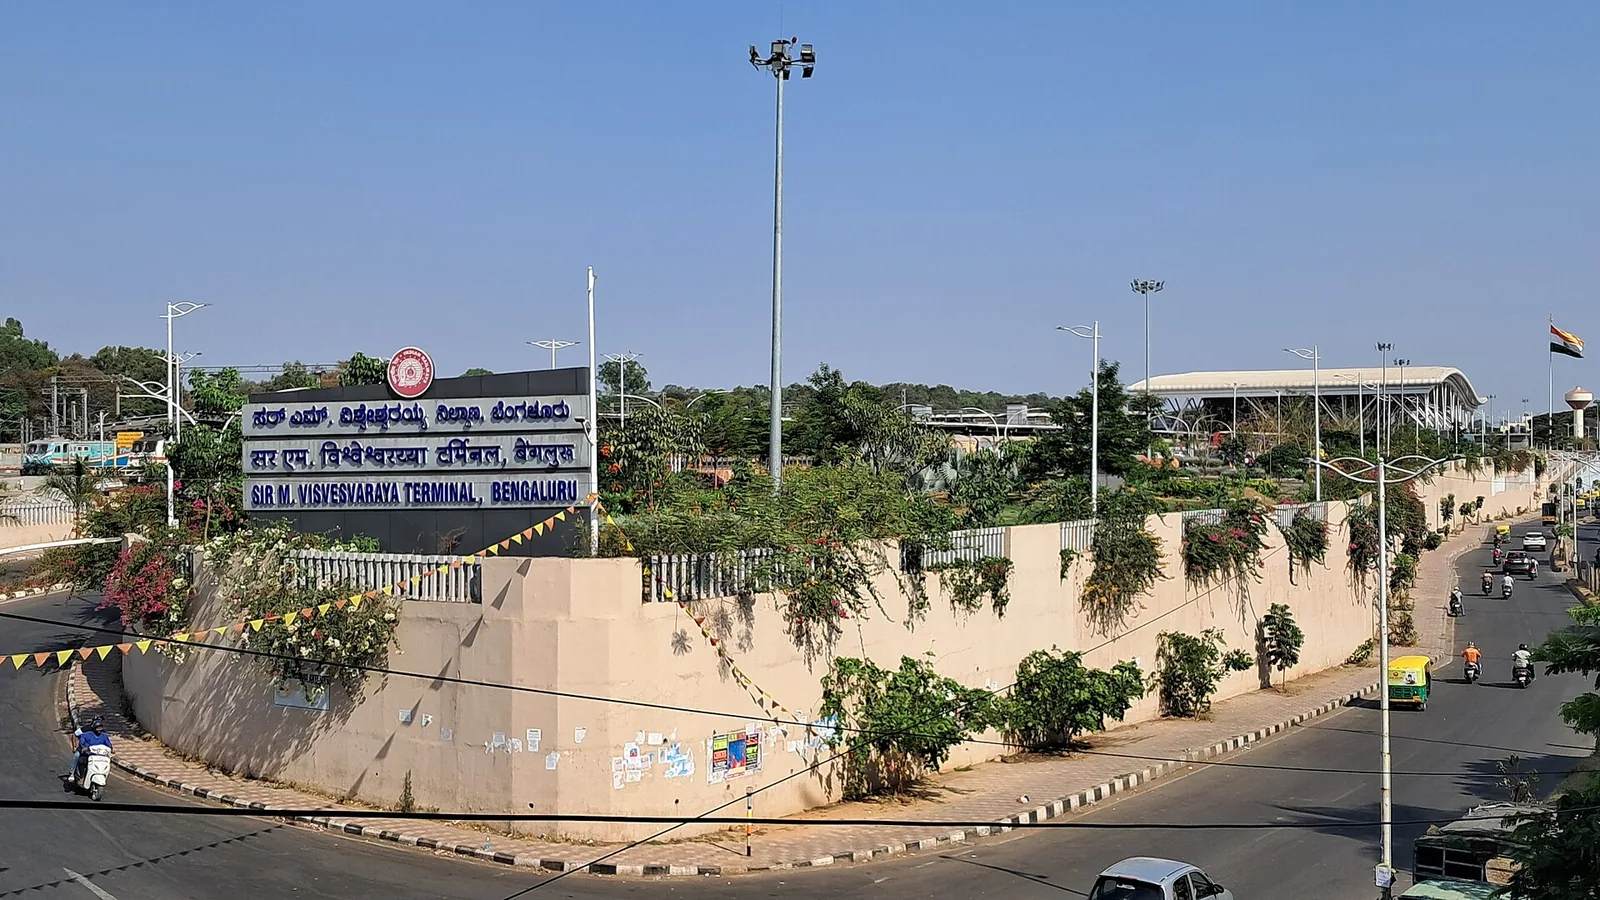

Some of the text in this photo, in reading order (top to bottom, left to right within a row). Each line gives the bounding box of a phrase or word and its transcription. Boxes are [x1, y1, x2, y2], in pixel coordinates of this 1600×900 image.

[252, 406, 286, 426] ಸರ್
[491, 399, 571, 420] ಬೆಂಗಳೂರು
[251, 449, 279, 467] सर
[282, 449, 316, 470] एम.
[320, 440, 429, 466] विश्वेश्वरय्या
[436, 438, 508, 467] टर्मिनल,
[252, 479, 579, 505] SIR M. VISVESVARAYA TERMINAL, BENGALURU
